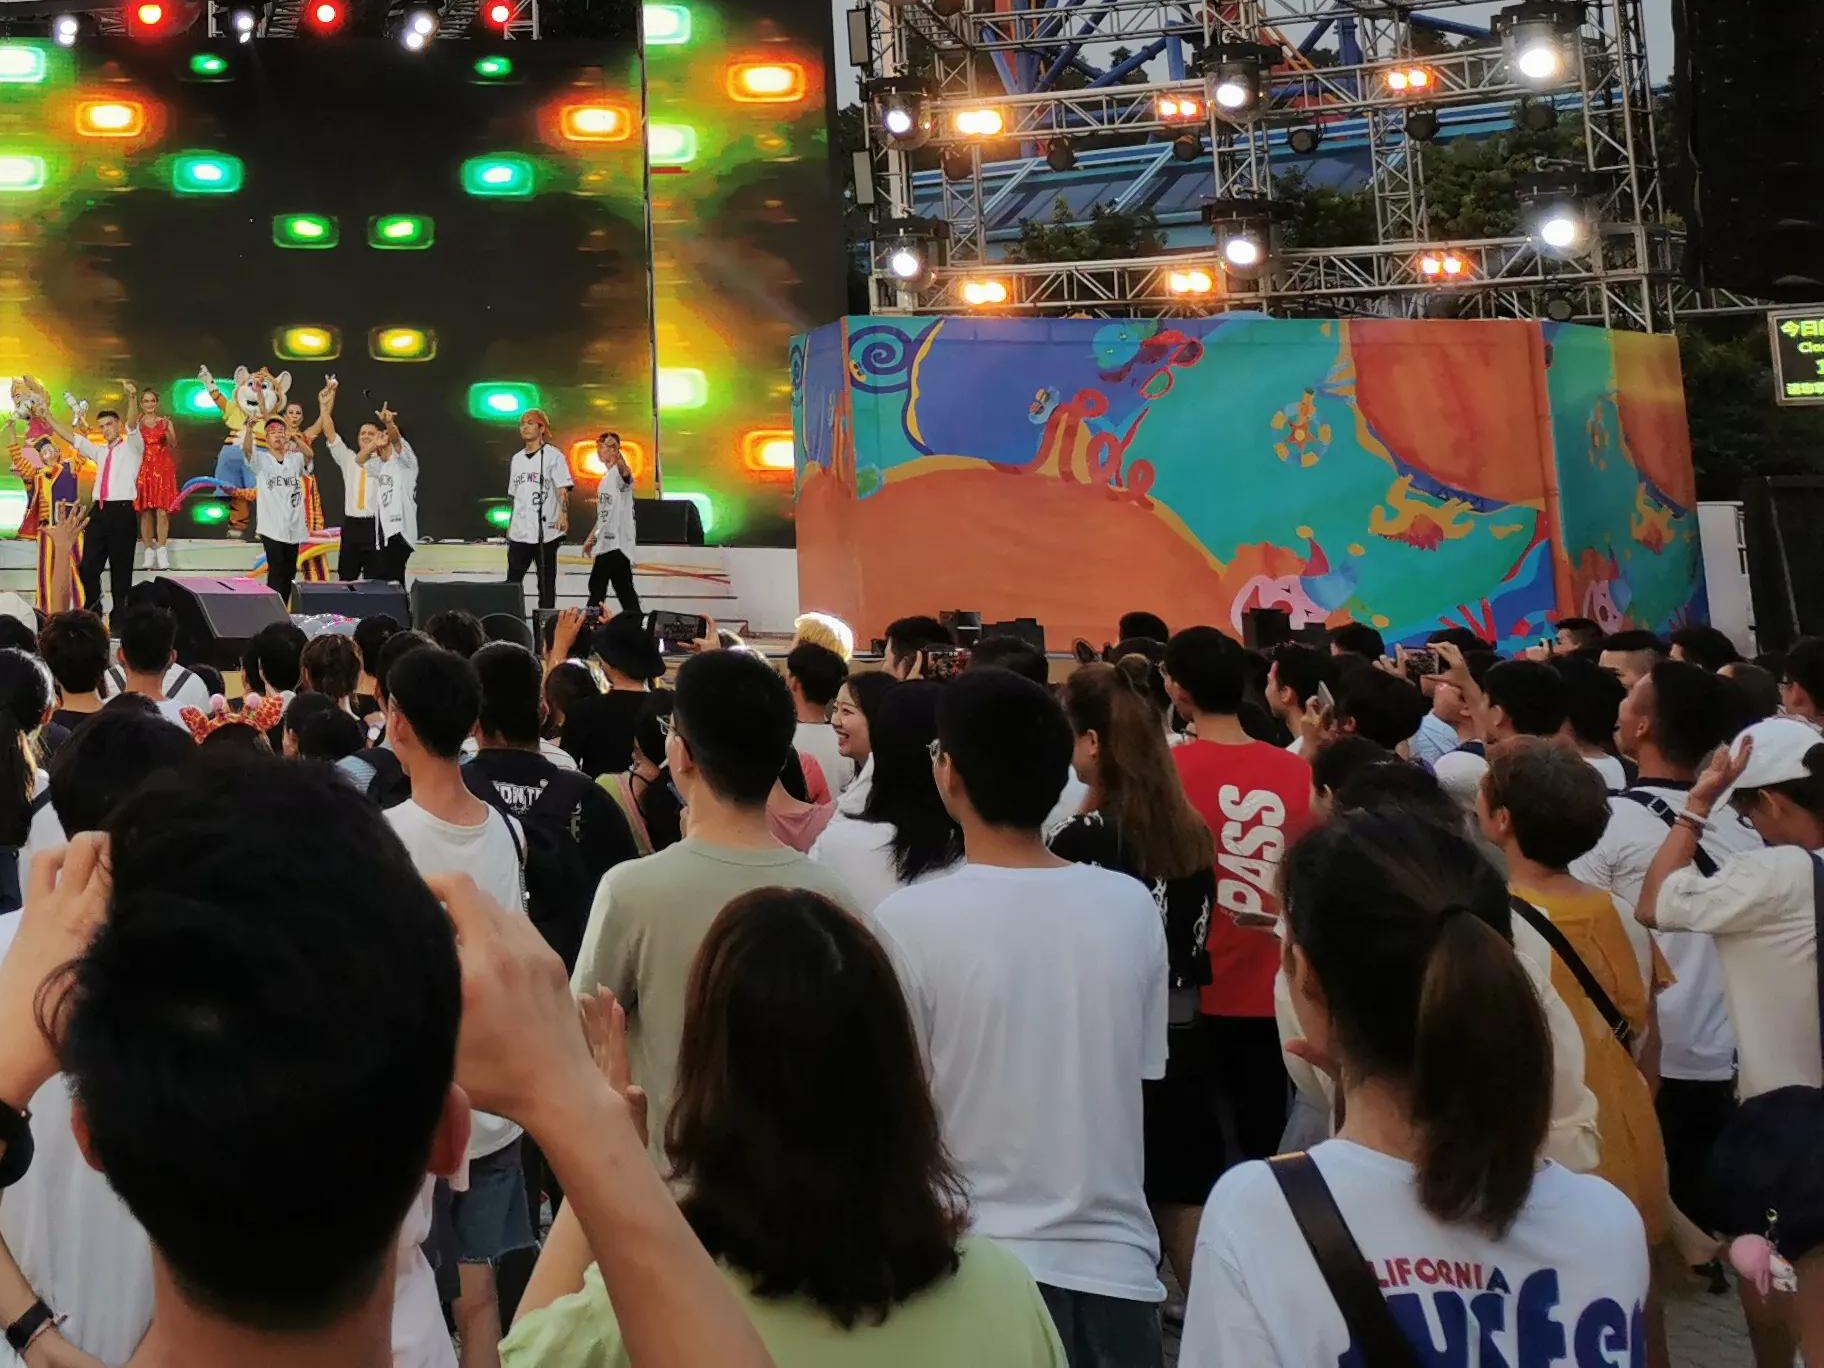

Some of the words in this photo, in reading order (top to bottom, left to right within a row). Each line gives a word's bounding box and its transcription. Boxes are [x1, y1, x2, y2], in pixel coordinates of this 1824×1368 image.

[1780, 318, 1824, 337] 今日
[1217, 784, 1286, 921] PASS
[1366, 1256, 1511, 1295] LIFORNIA
